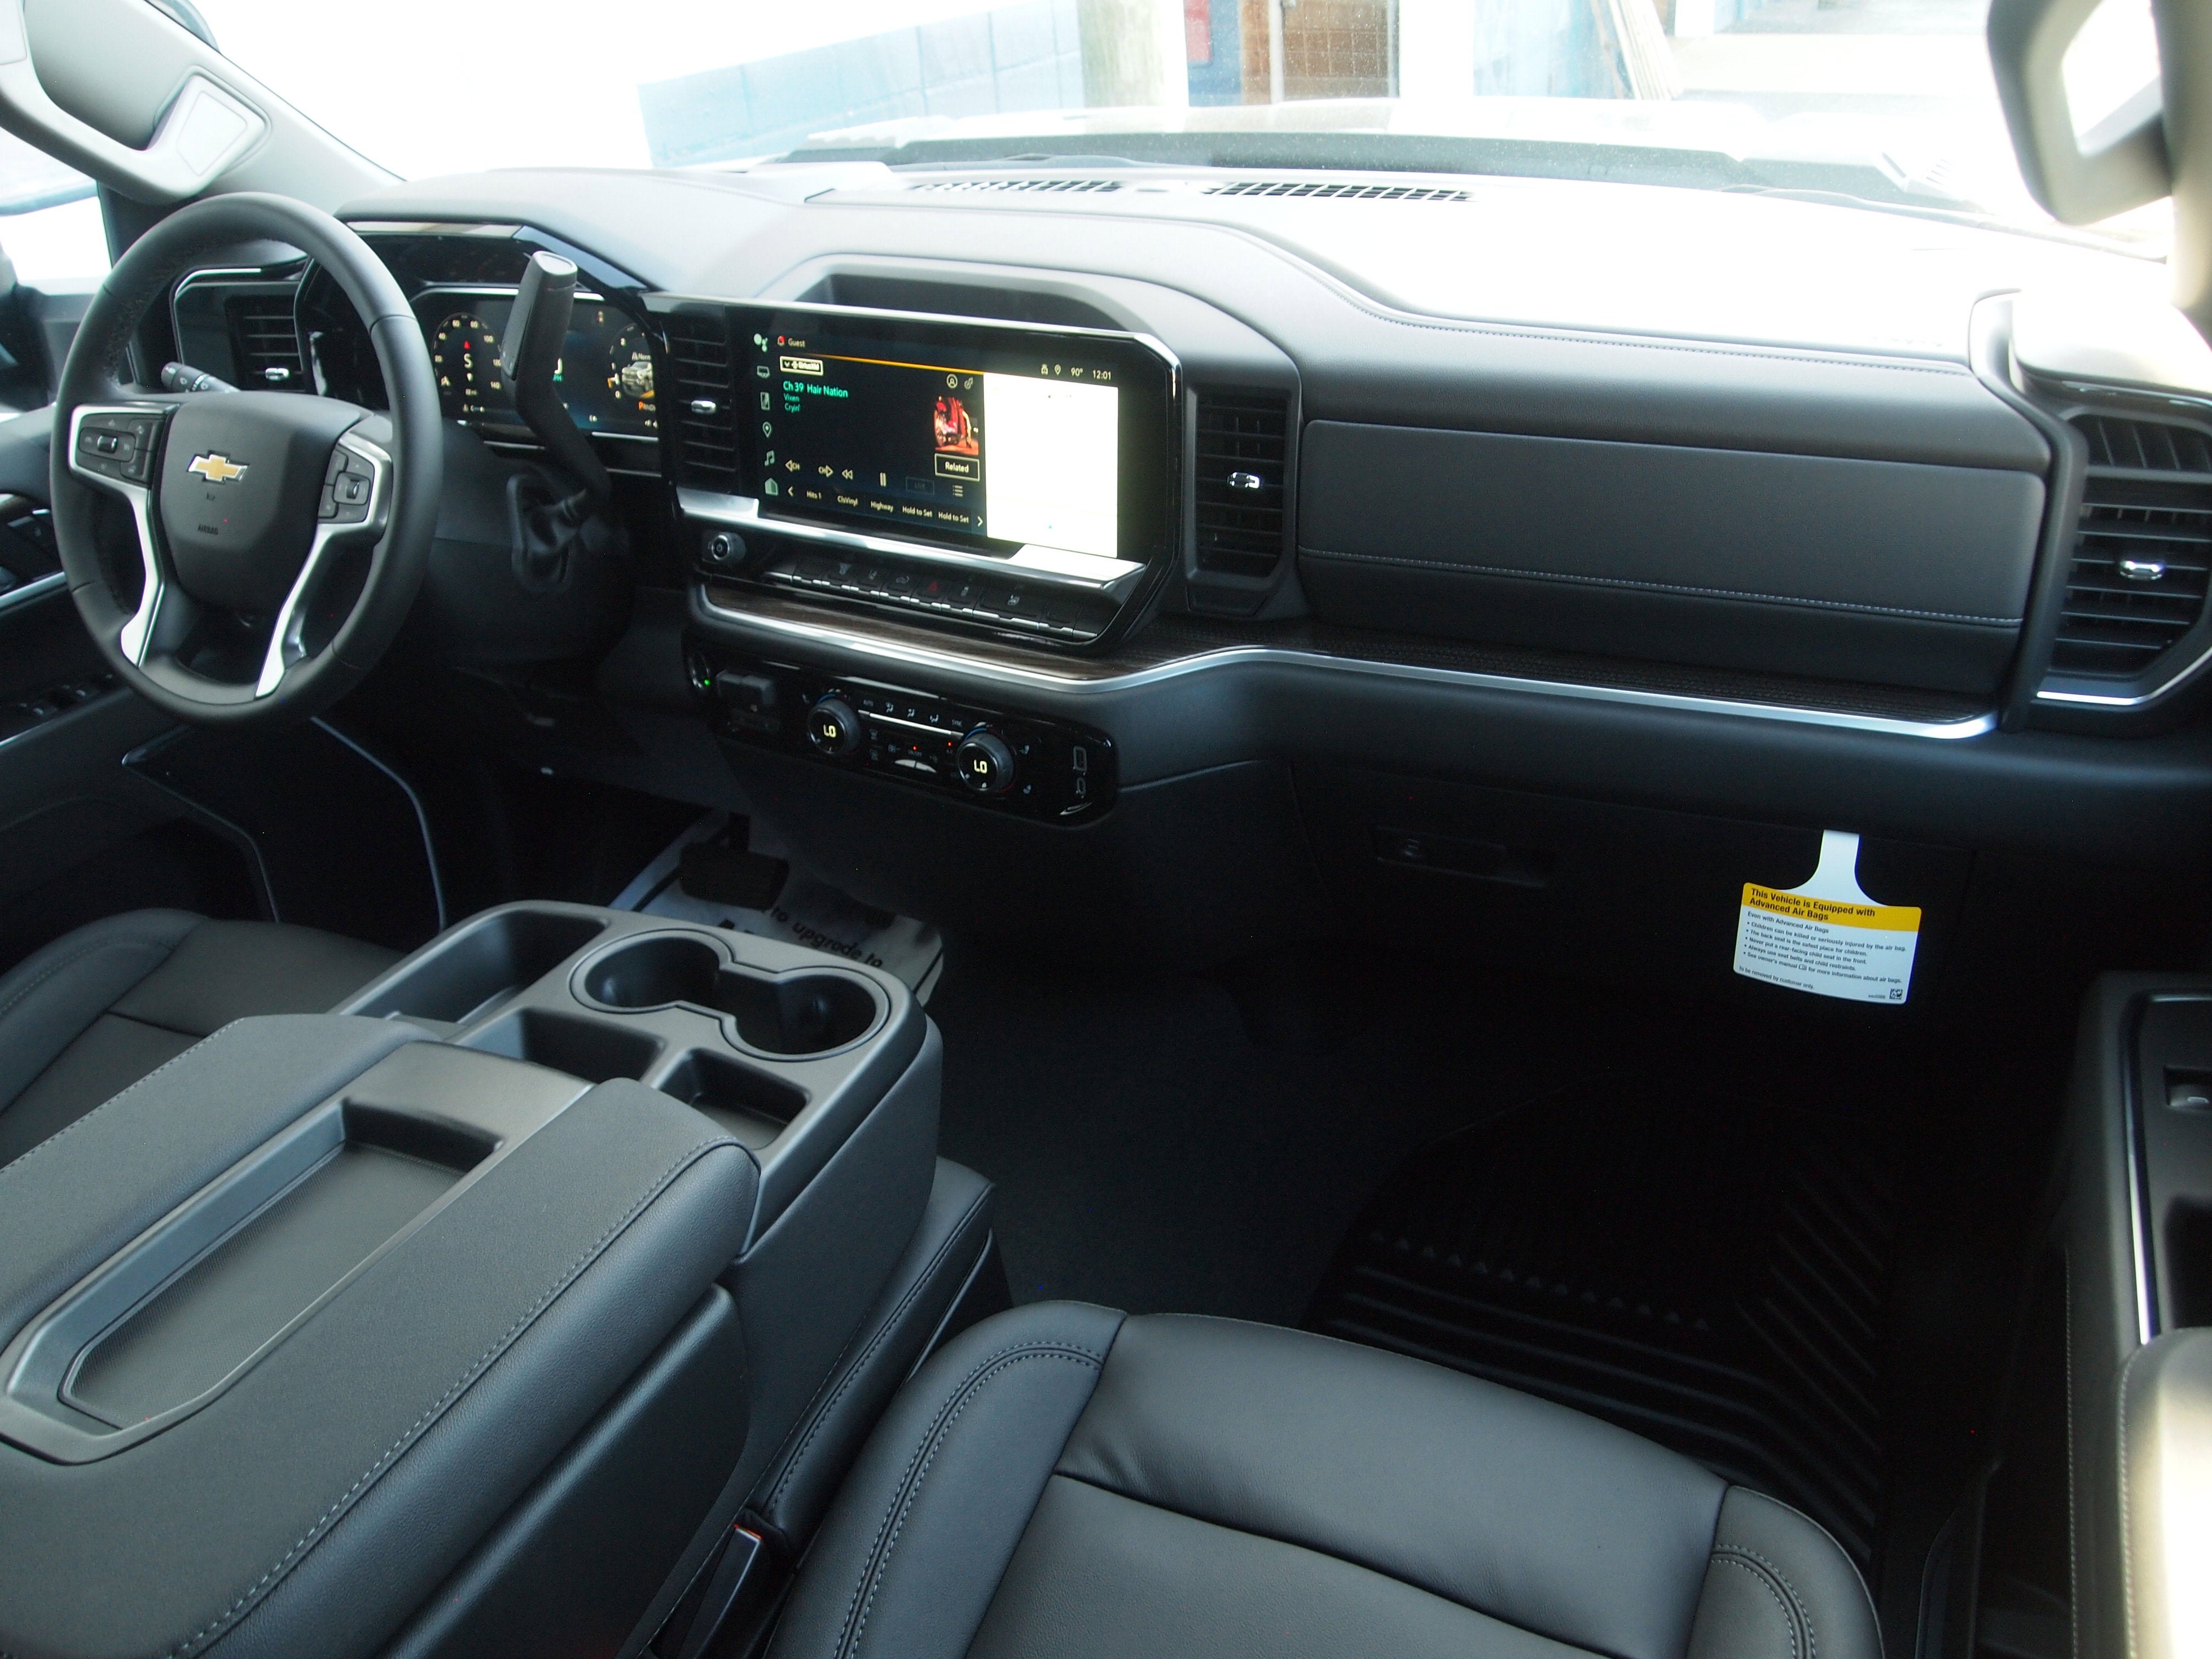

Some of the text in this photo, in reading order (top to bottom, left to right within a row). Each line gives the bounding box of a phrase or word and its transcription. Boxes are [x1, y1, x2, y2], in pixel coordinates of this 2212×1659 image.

[788, 338, 805, 348] Guest
[464, 353, 473, 369] S
[1093, 370, 1111, 380] 12:01
[783, 381, 848, 398] Ch 39 Hair Nation
[783, 393, 800, 402] Vixen
[945, 461, 969, 473] Related
[806, 490, 817, 499] Hits
[871, 501, 894, 512] Highway
[902, 506, 915, 514] Hold
[924, 509, 933, 517] Set
[938, 512, 951, 520] Hold
[960, 515, 969, 523] Set
[1750, 898, 1829, 921] Advanced Air Bags
[1752, 888, 1876, 917] This Vehicle is Equipped with
[1763, 914, 1774, 922] with
[1775, 918, 1803, 928] Advanced
[770, 906, 788, 922] to
[865, 952, 883, 968] to
[1751, 922, 1773, 932] Children
[1794, 931, 1809, 939] killed
[1818, 937, 1843, 946] seriously
[1748, 944, 1766, 953] Always
[1749, 936, 1764, 945] Never
[1779, 945, 1808, 956] rear-facing
[1758, 955, 1778, 964] owner's
[1832, 970, 1862, 979] information
[1752, 970, 1771, 979] removed
[1780, 978, 1802, 986] customer
